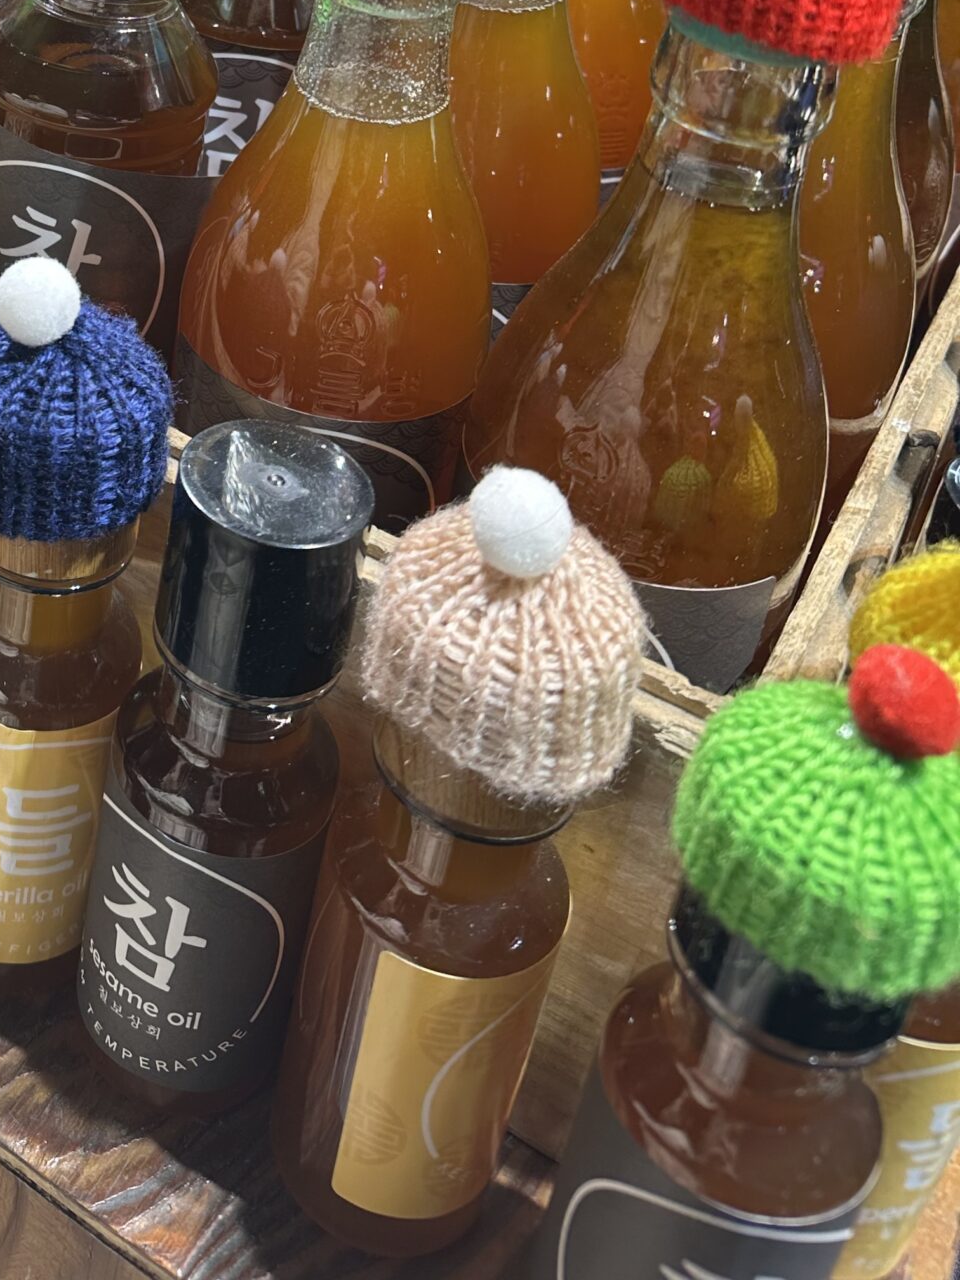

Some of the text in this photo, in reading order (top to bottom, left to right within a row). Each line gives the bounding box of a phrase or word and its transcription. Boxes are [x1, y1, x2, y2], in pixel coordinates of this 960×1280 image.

[61, 870, 89, 898] oil
[103, 862, 208, 993] 참
[89, 937, 202, 1031] sesame oil
[86, 1002, 248, 1073] TEMPERATURE
